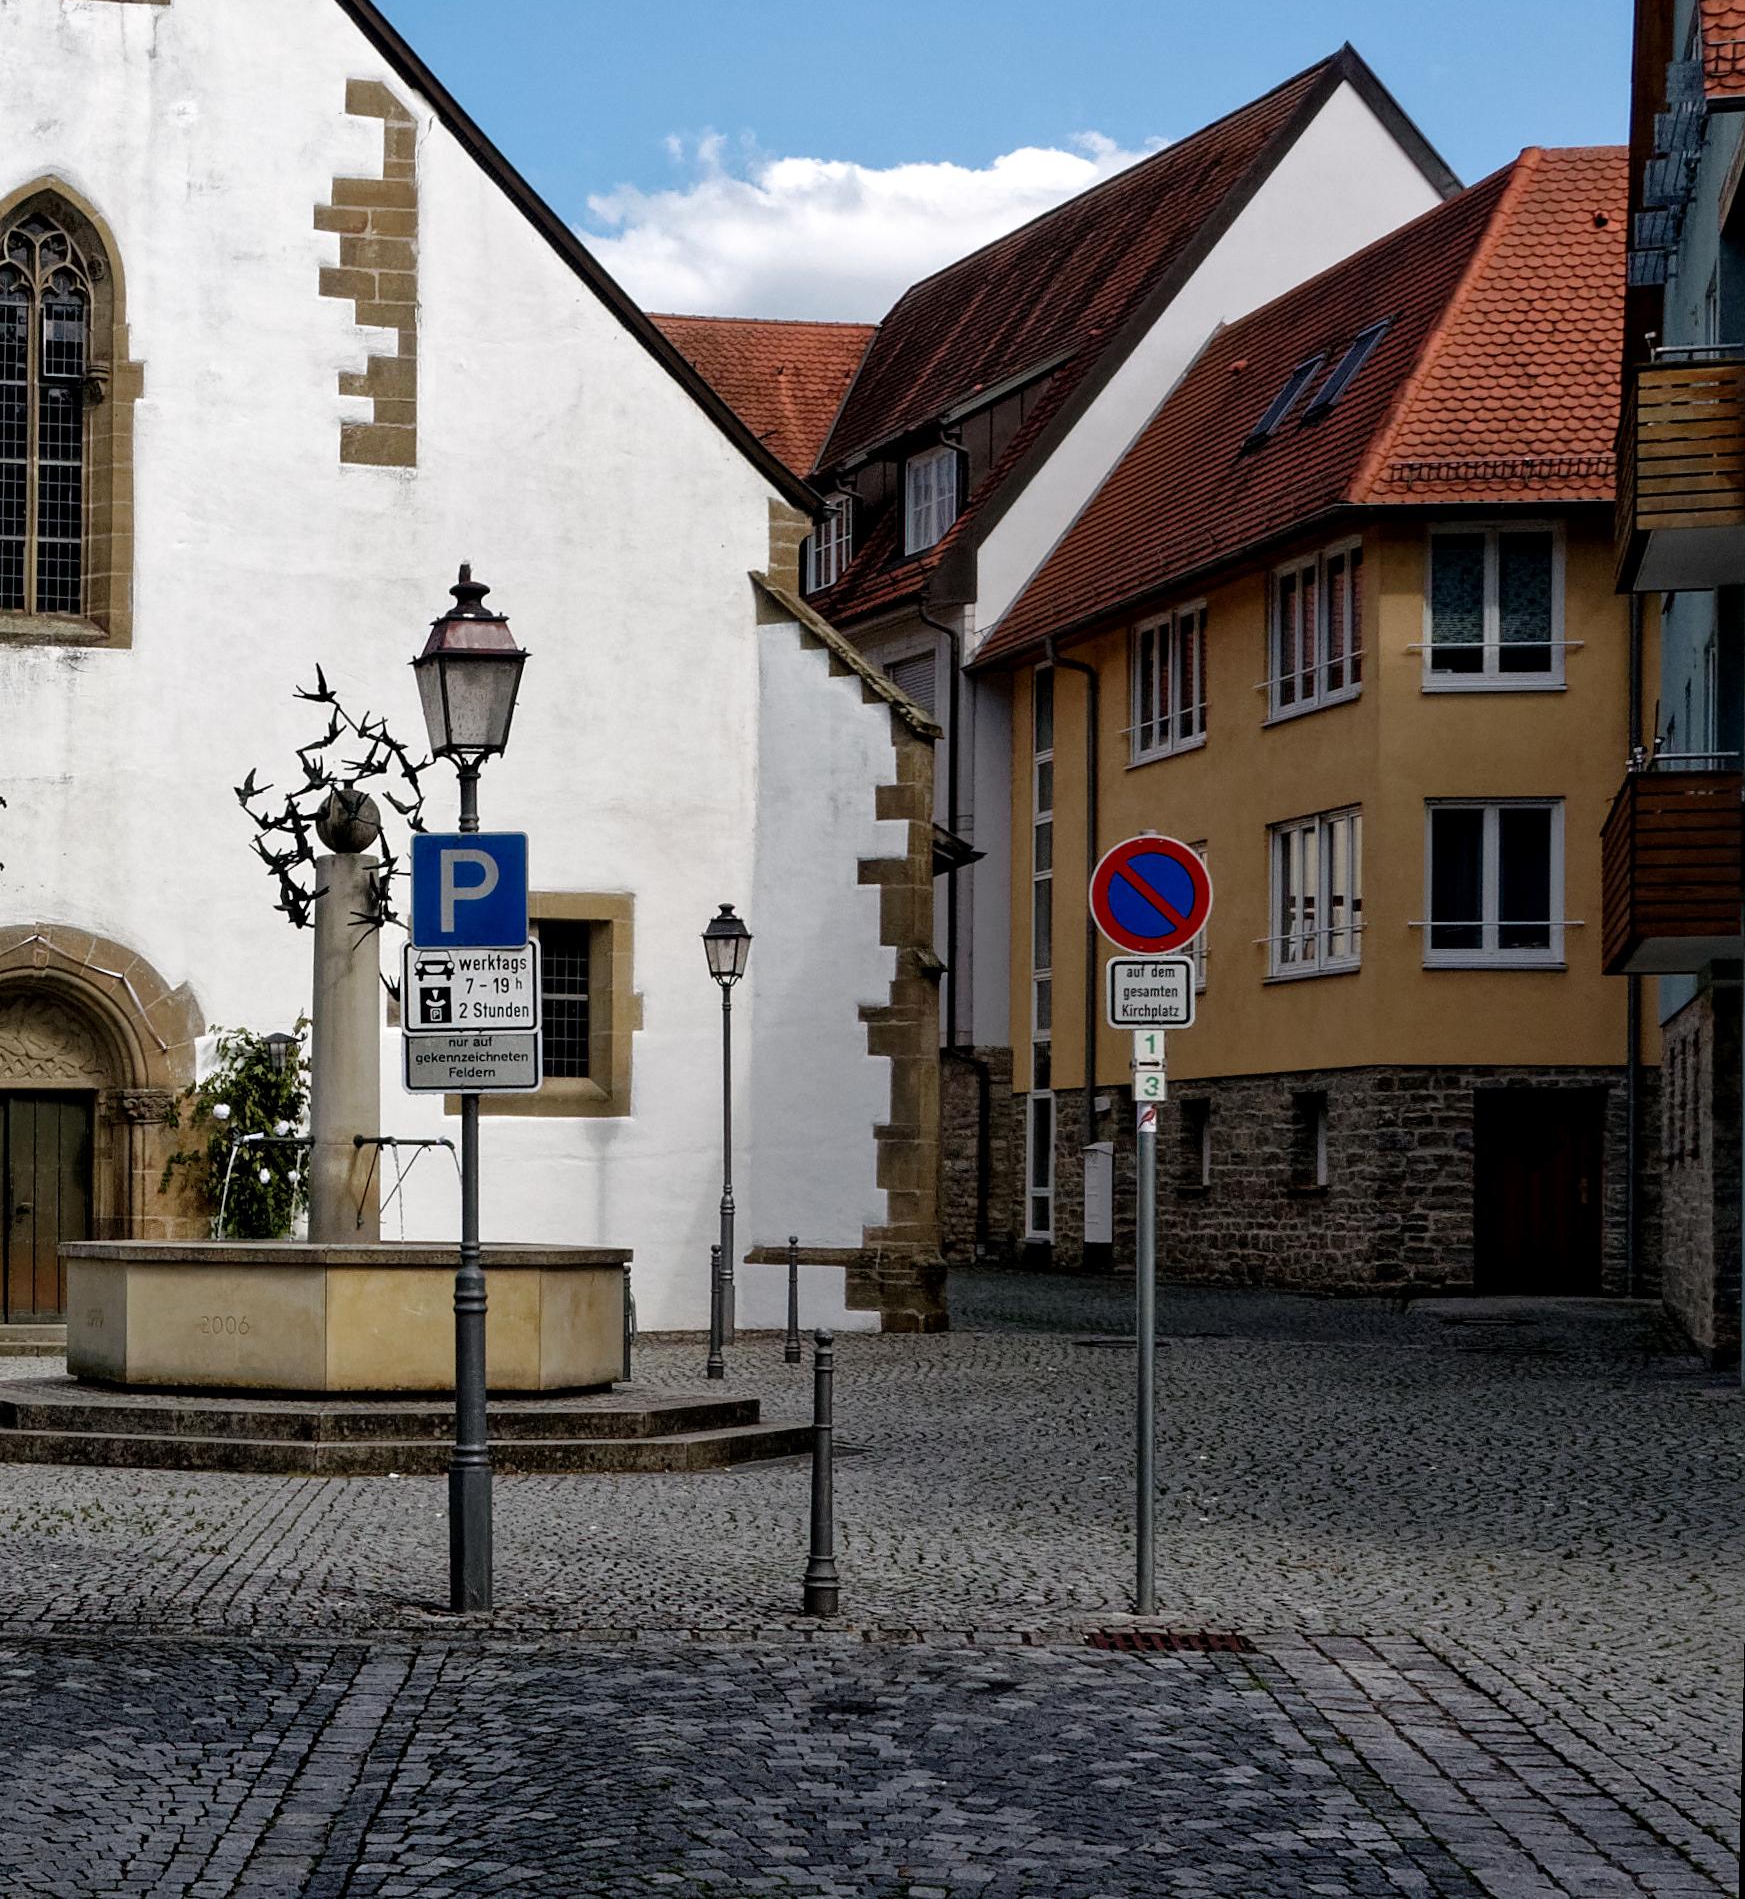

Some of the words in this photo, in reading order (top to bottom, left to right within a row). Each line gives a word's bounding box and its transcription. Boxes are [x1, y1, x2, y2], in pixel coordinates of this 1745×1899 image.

[440, 849, 499, 933] P
[458, 954, 527, 974] werktags
[1126, 965, 1145, 978] auf
[1151, 965, 1175, 978] dem
[466, 978, 474, 994] 7
[493, 978, 509, 994] 19
[1123, 985, 1178, 1001] gesamten
[459, 1002, 468, 1019] 2
[473, 1002, 529, 1018] Stunden
[1122, 1004, 1180, 1019] Kirchplatz
[448, 1038, 469, 1048] nur
[473, 1037, 493, 1047] auf
[1145, 1034, 1155, 1054] 1
[415, 1051, 529, 1065] gekennzeichneten
[448, 1067, 496, 1078] Feldern
[1144, 1076, 1160, 1097] 3
[200, 1315, 251, 1335] 2006
